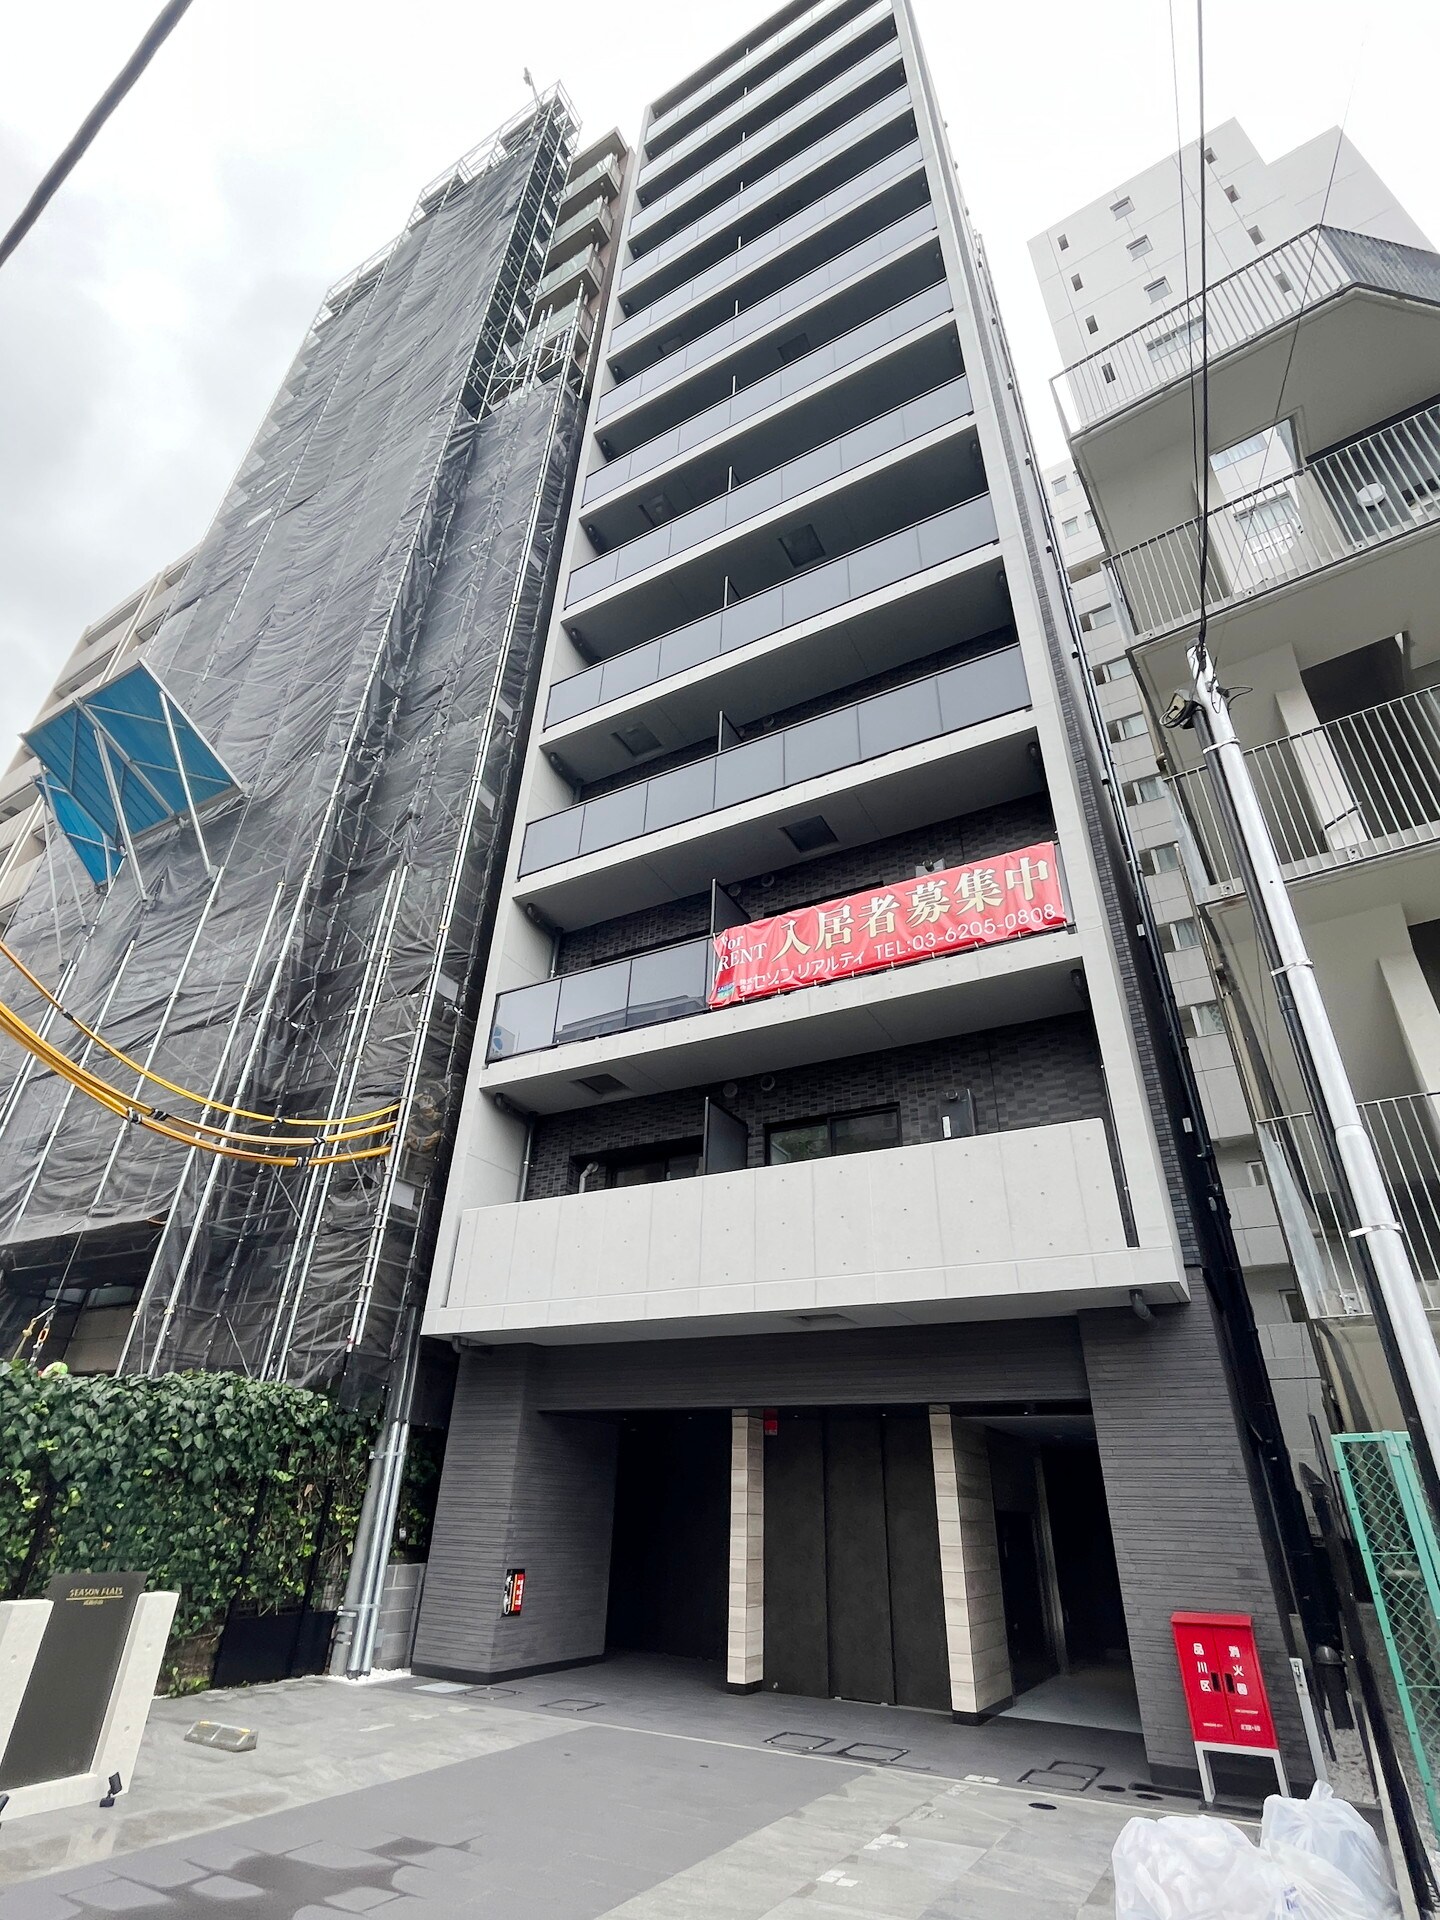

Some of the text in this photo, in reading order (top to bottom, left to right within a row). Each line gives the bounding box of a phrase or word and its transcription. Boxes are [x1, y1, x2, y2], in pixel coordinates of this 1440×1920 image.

[772, 857, 1048, 962] 入居者募集中
[874, 903, 1056, 960] TEL:03-6205-0808
[717, 942, 768, 972] RENT
[1193, 1642, 1212, 1693] 品川区
